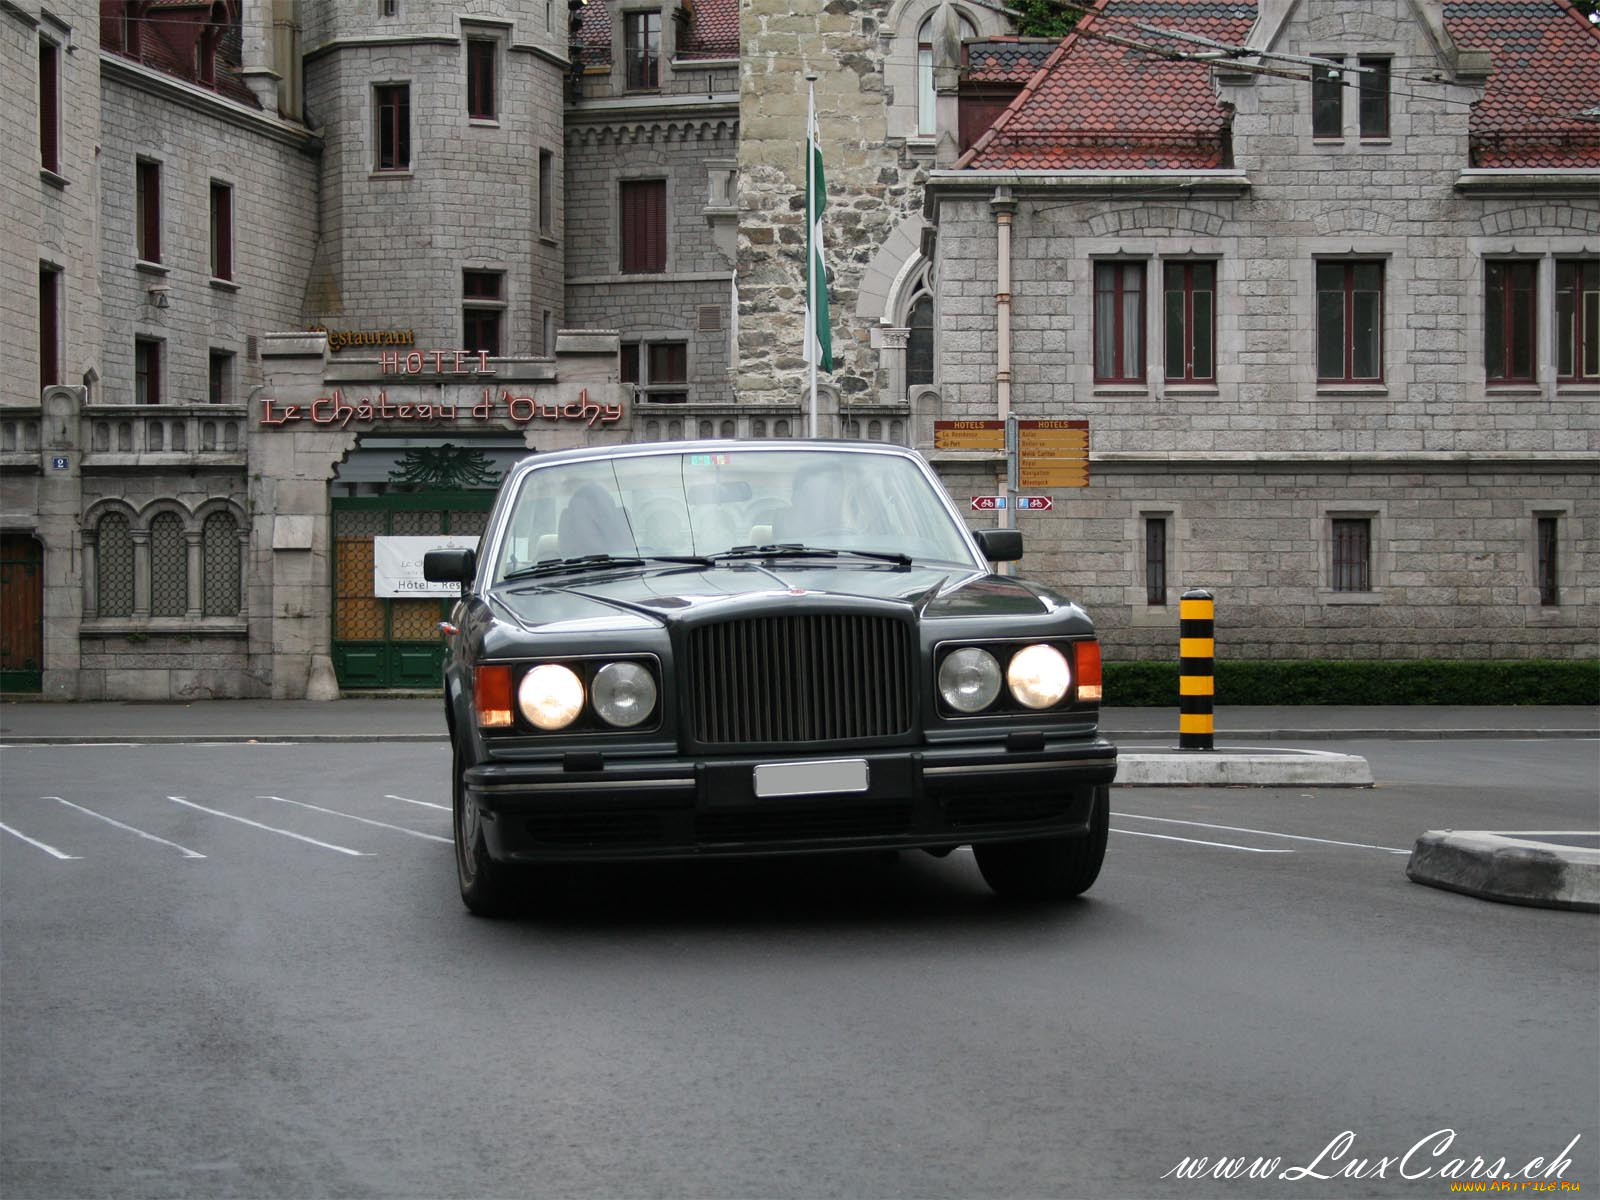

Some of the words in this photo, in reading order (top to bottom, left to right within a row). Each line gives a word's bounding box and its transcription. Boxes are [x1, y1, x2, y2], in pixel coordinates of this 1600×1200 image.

[312, 326, 415, 351] estaurant
[378, 349, 497, 374] HOTEL
[259, 398, 302, 424] Le
[310, 388, 456, 428] Château
[472, 388, 623, 427] d'Ouchy
[954, 421, 985, 429] HOTELS
[1038, 421, 1069, 429] HOTELS
[57, 458, 64, 468] 2
[398, 580, 429, 590] Hôtel
